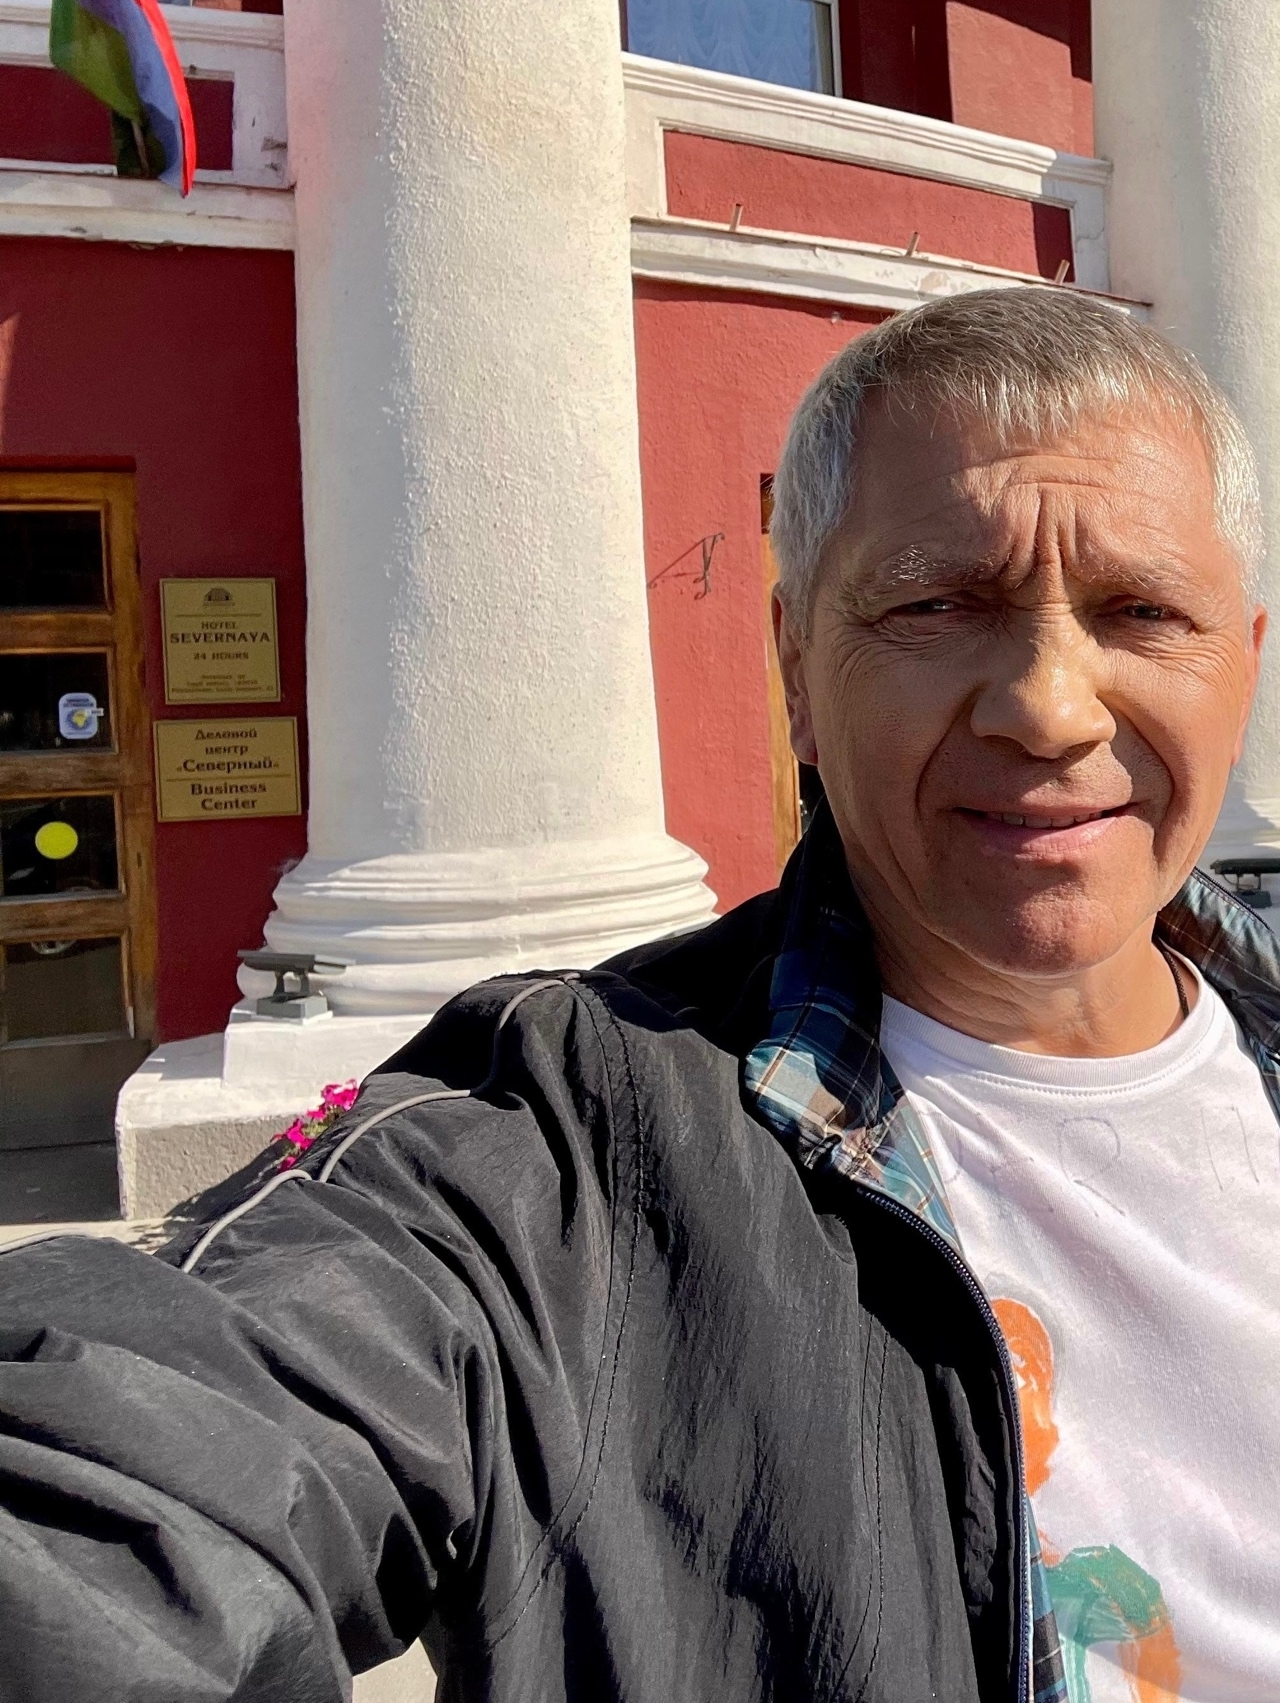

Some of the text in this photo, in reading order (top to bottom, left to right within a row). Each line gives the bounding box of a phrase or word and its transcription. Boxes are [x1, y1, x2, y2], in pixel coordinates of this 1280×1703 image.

[201, 621, 237, 630] HOTEL
[170, 632, 271, 644] SEVERNAYA
[195, 728, 258, 740] Деловой
[205, 745, 248, 756] центр
[191, 781, 267, 796] Business
[201, 798, 258, 811] Center
